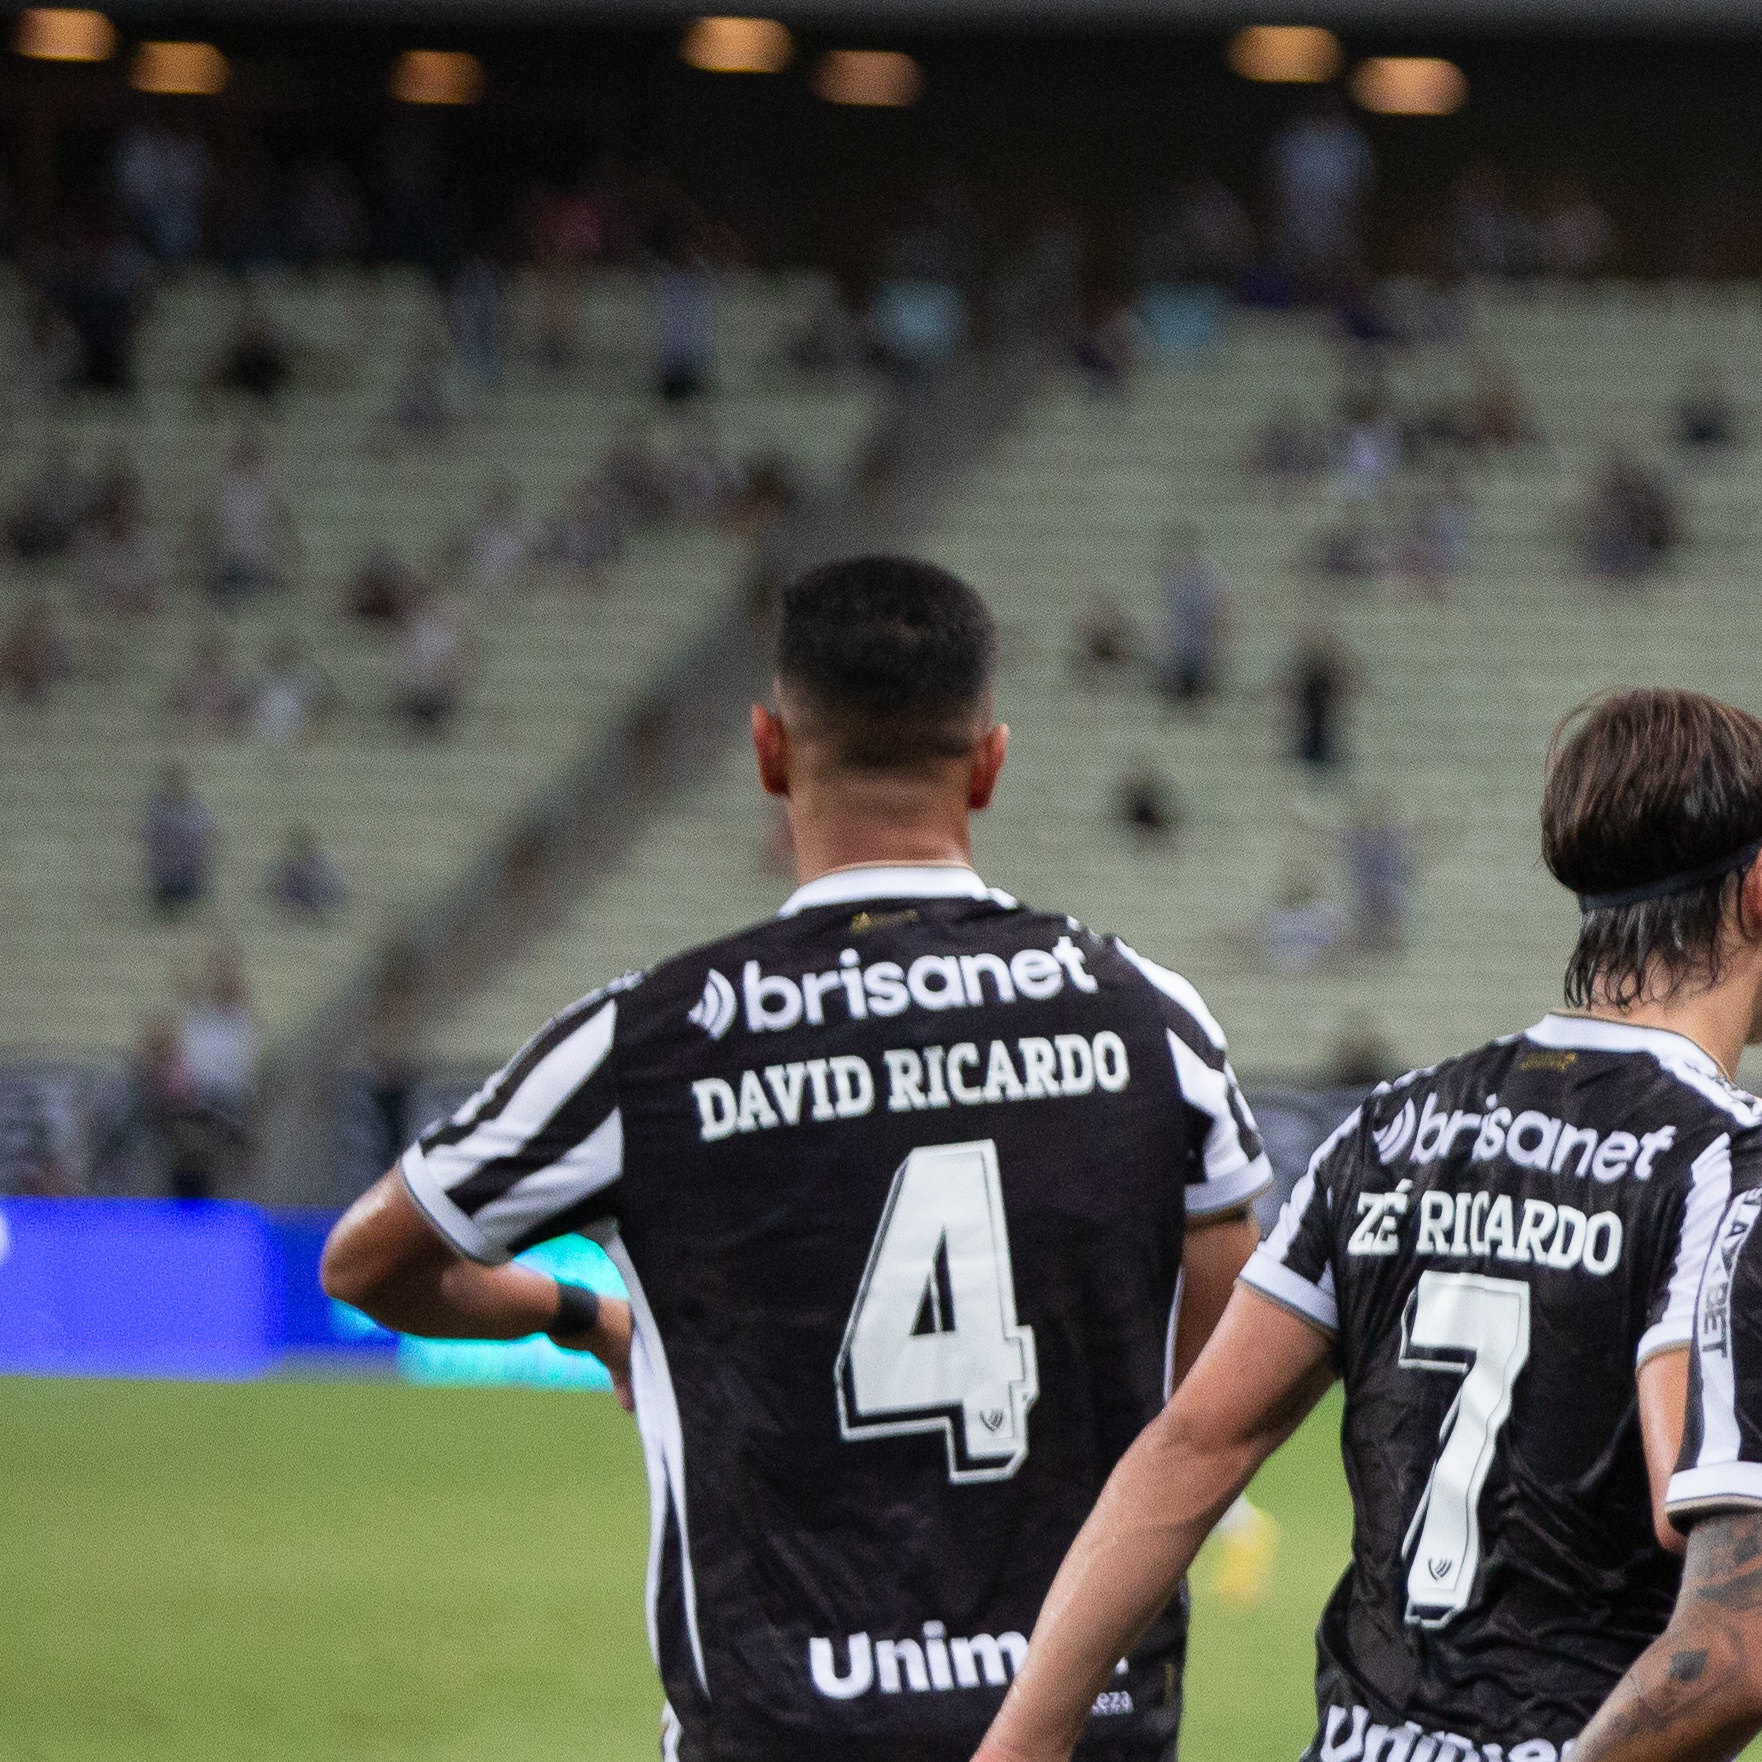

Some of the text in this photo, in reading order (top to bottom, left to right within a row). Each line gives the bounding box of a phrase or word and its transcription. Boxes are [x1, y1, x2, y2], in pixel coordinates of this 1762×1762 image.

[742, 936, 1097, 1032] brisanet
[692, 1030, 1130, 1142] DAVID RICARDO
[1410, 1092, 1677, 1183] brisanet
[1347, 1178, 1623, 1276] ZÉ RICARDO
[835, 1138, 1039, 1484] 4
[1399, 1271, 1531, 1627] 7
[810, 1620, 1029, 1699] Unim
